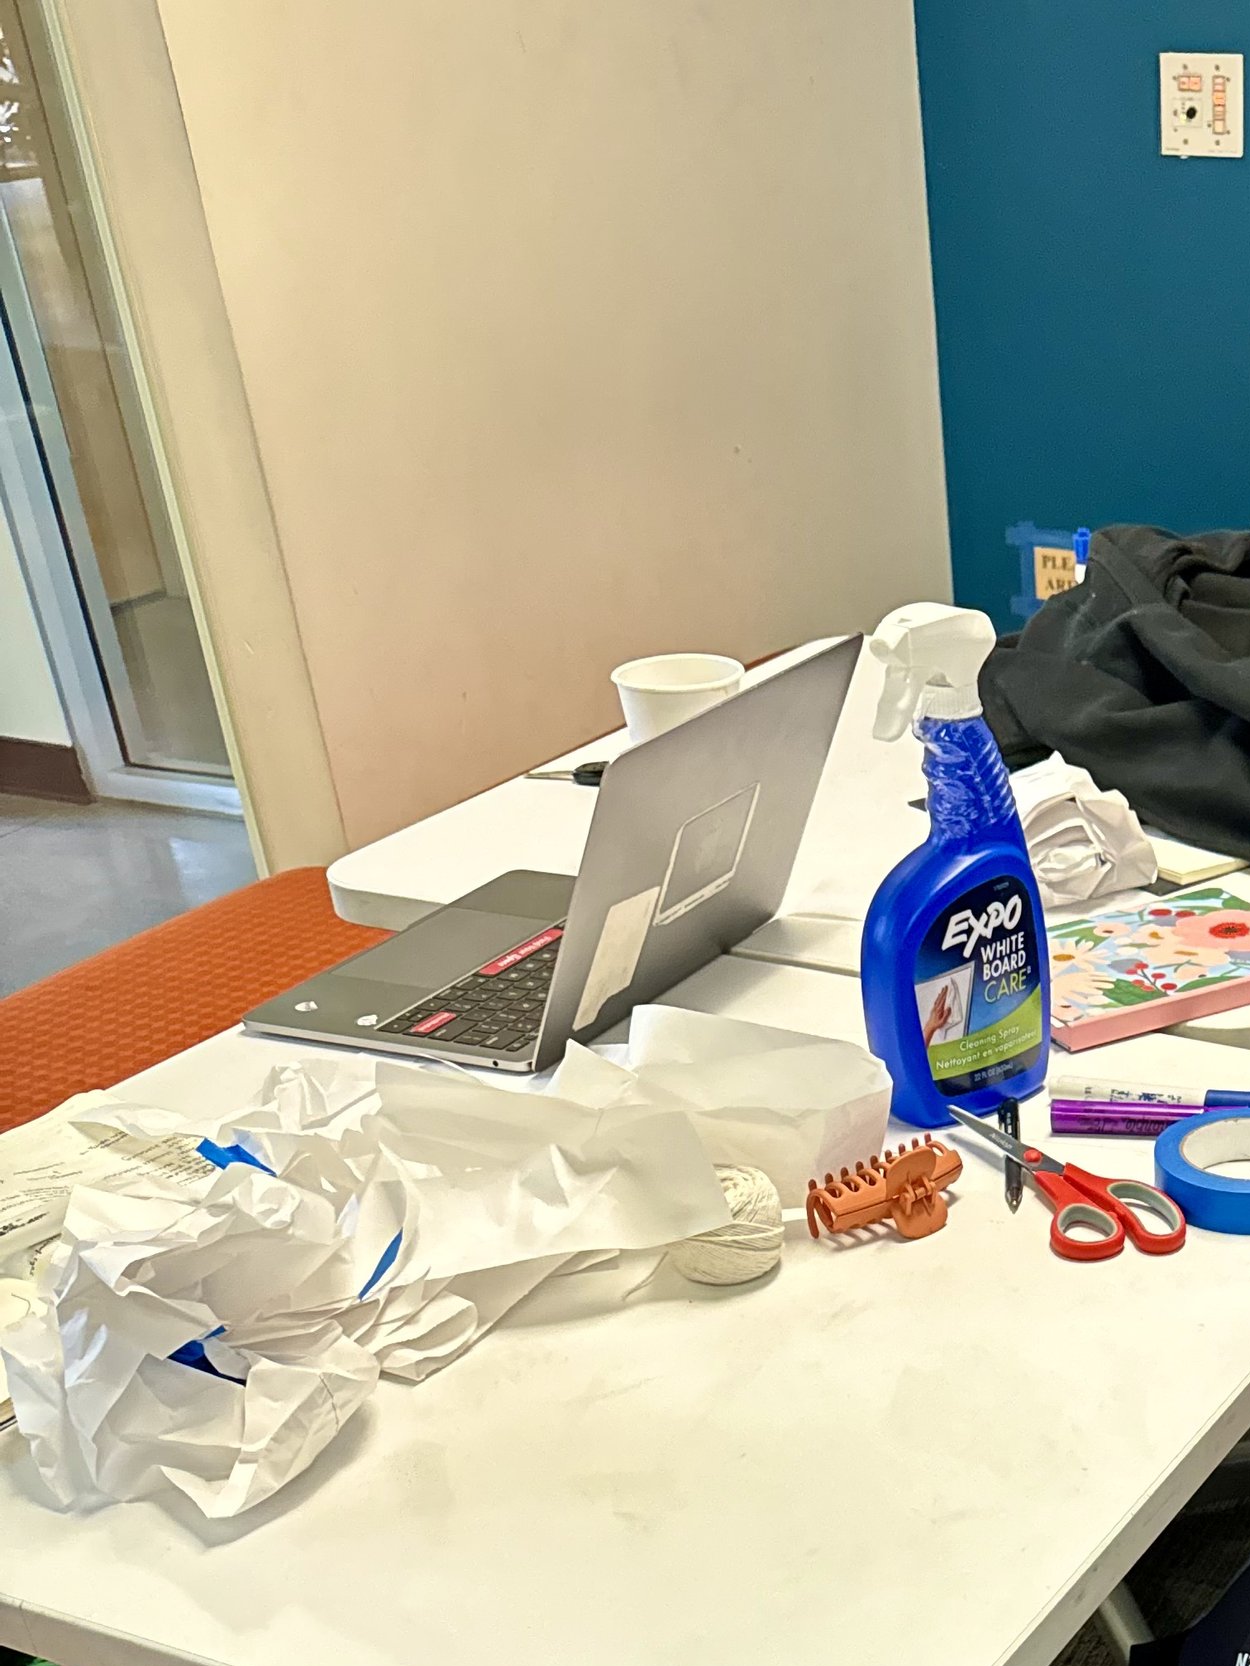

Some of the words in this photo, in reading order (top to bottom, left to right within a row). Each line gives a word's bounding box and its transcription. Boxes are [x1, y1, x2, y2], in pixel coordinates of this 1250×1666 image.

[1041, 555, 1075, 571] PLE
[941, 894, 1023, 959] EXPO
[980, 931, 1025, 963] WHITE
[983, 950, 1026, 981] BOARD
[984, 968, 1027, 1003] CARE
[959, 1034, 997, 1052] Cleaning
[998, 1026, 1020, 1040] Spray
[935, 1052, 981, 1070] Nettoyant
[982, 1049, 993, 1058] en
